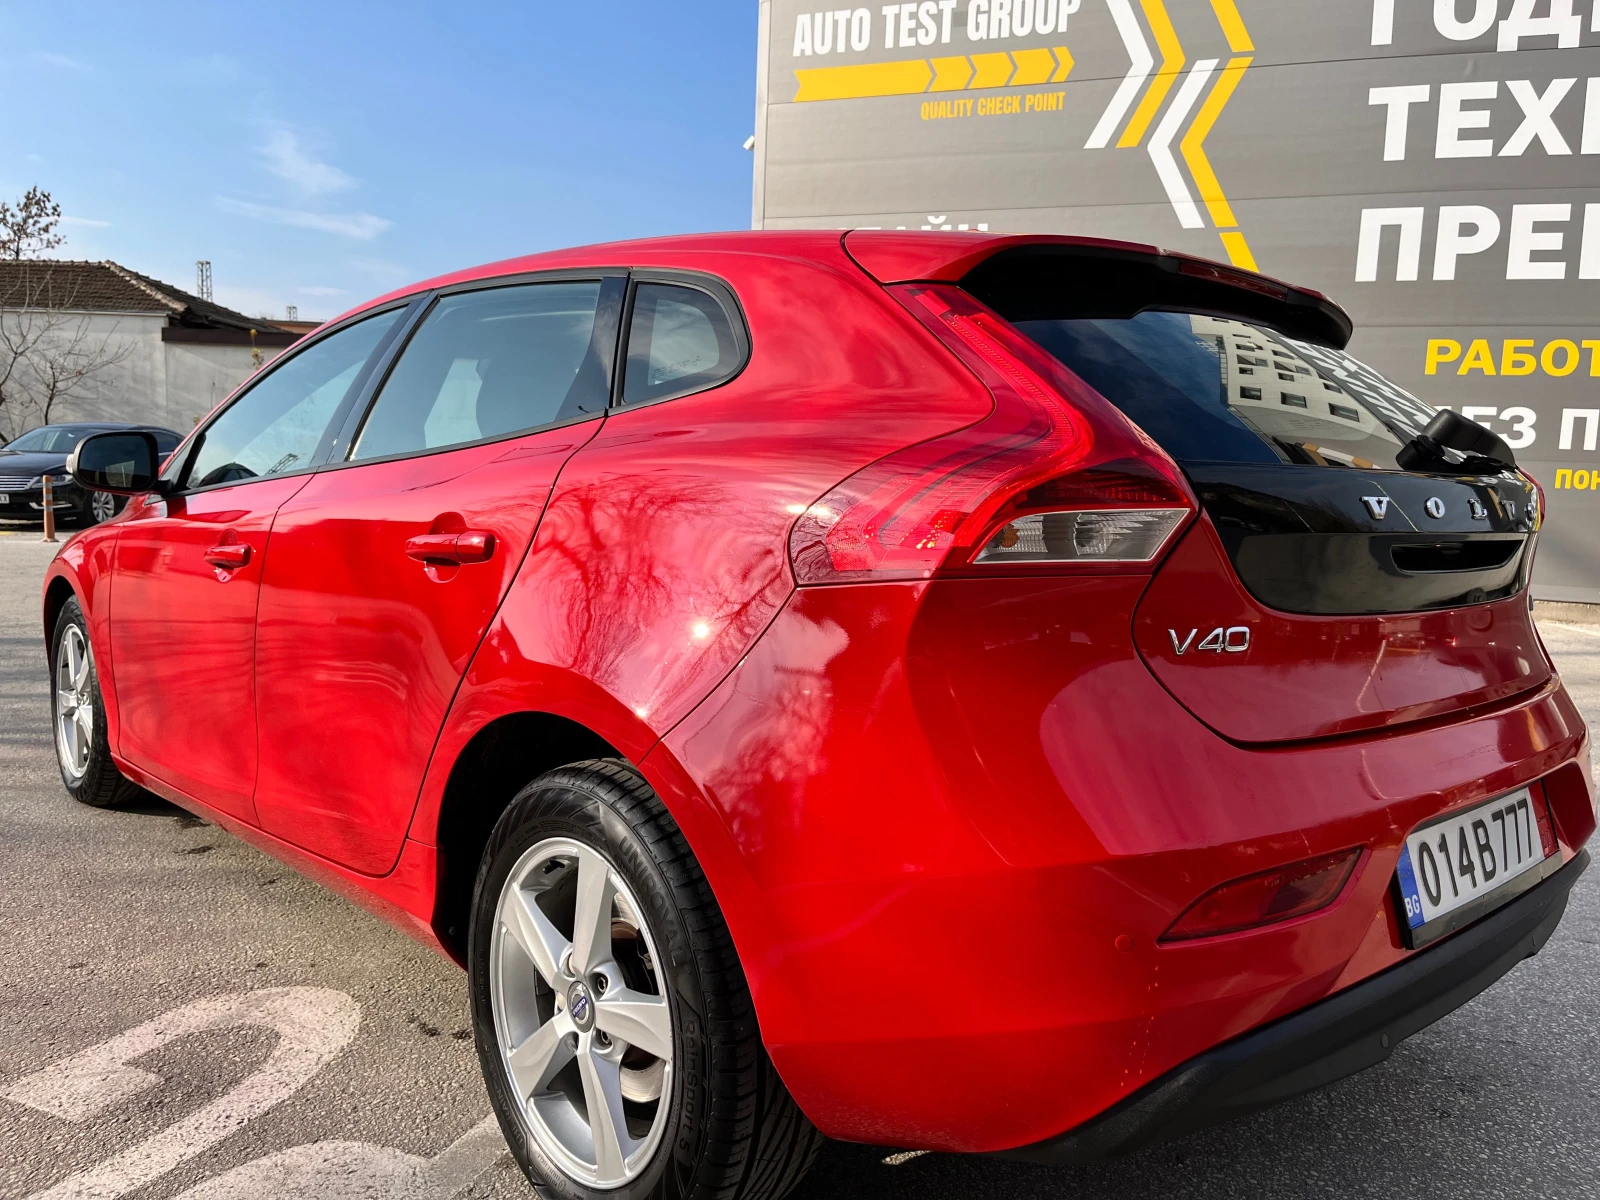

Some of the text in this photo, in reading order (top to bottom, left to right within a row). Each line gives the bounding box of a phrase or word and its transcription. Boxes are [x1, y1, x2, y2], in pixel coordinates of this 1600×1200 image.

[793, 0, 1080, 57] AUTO TEST GROUP
[921, 92, 1065, 120] QUALITY CHECK POINT
[1361, 496, 1536, 522] VOLVO
[1167, 626, 1250, 655] V40
[1418, 797, 1533, 908] 014B777
[619, 835, 683, 967] UNIROYAL
[1404, 894, 1421, 918] BG
